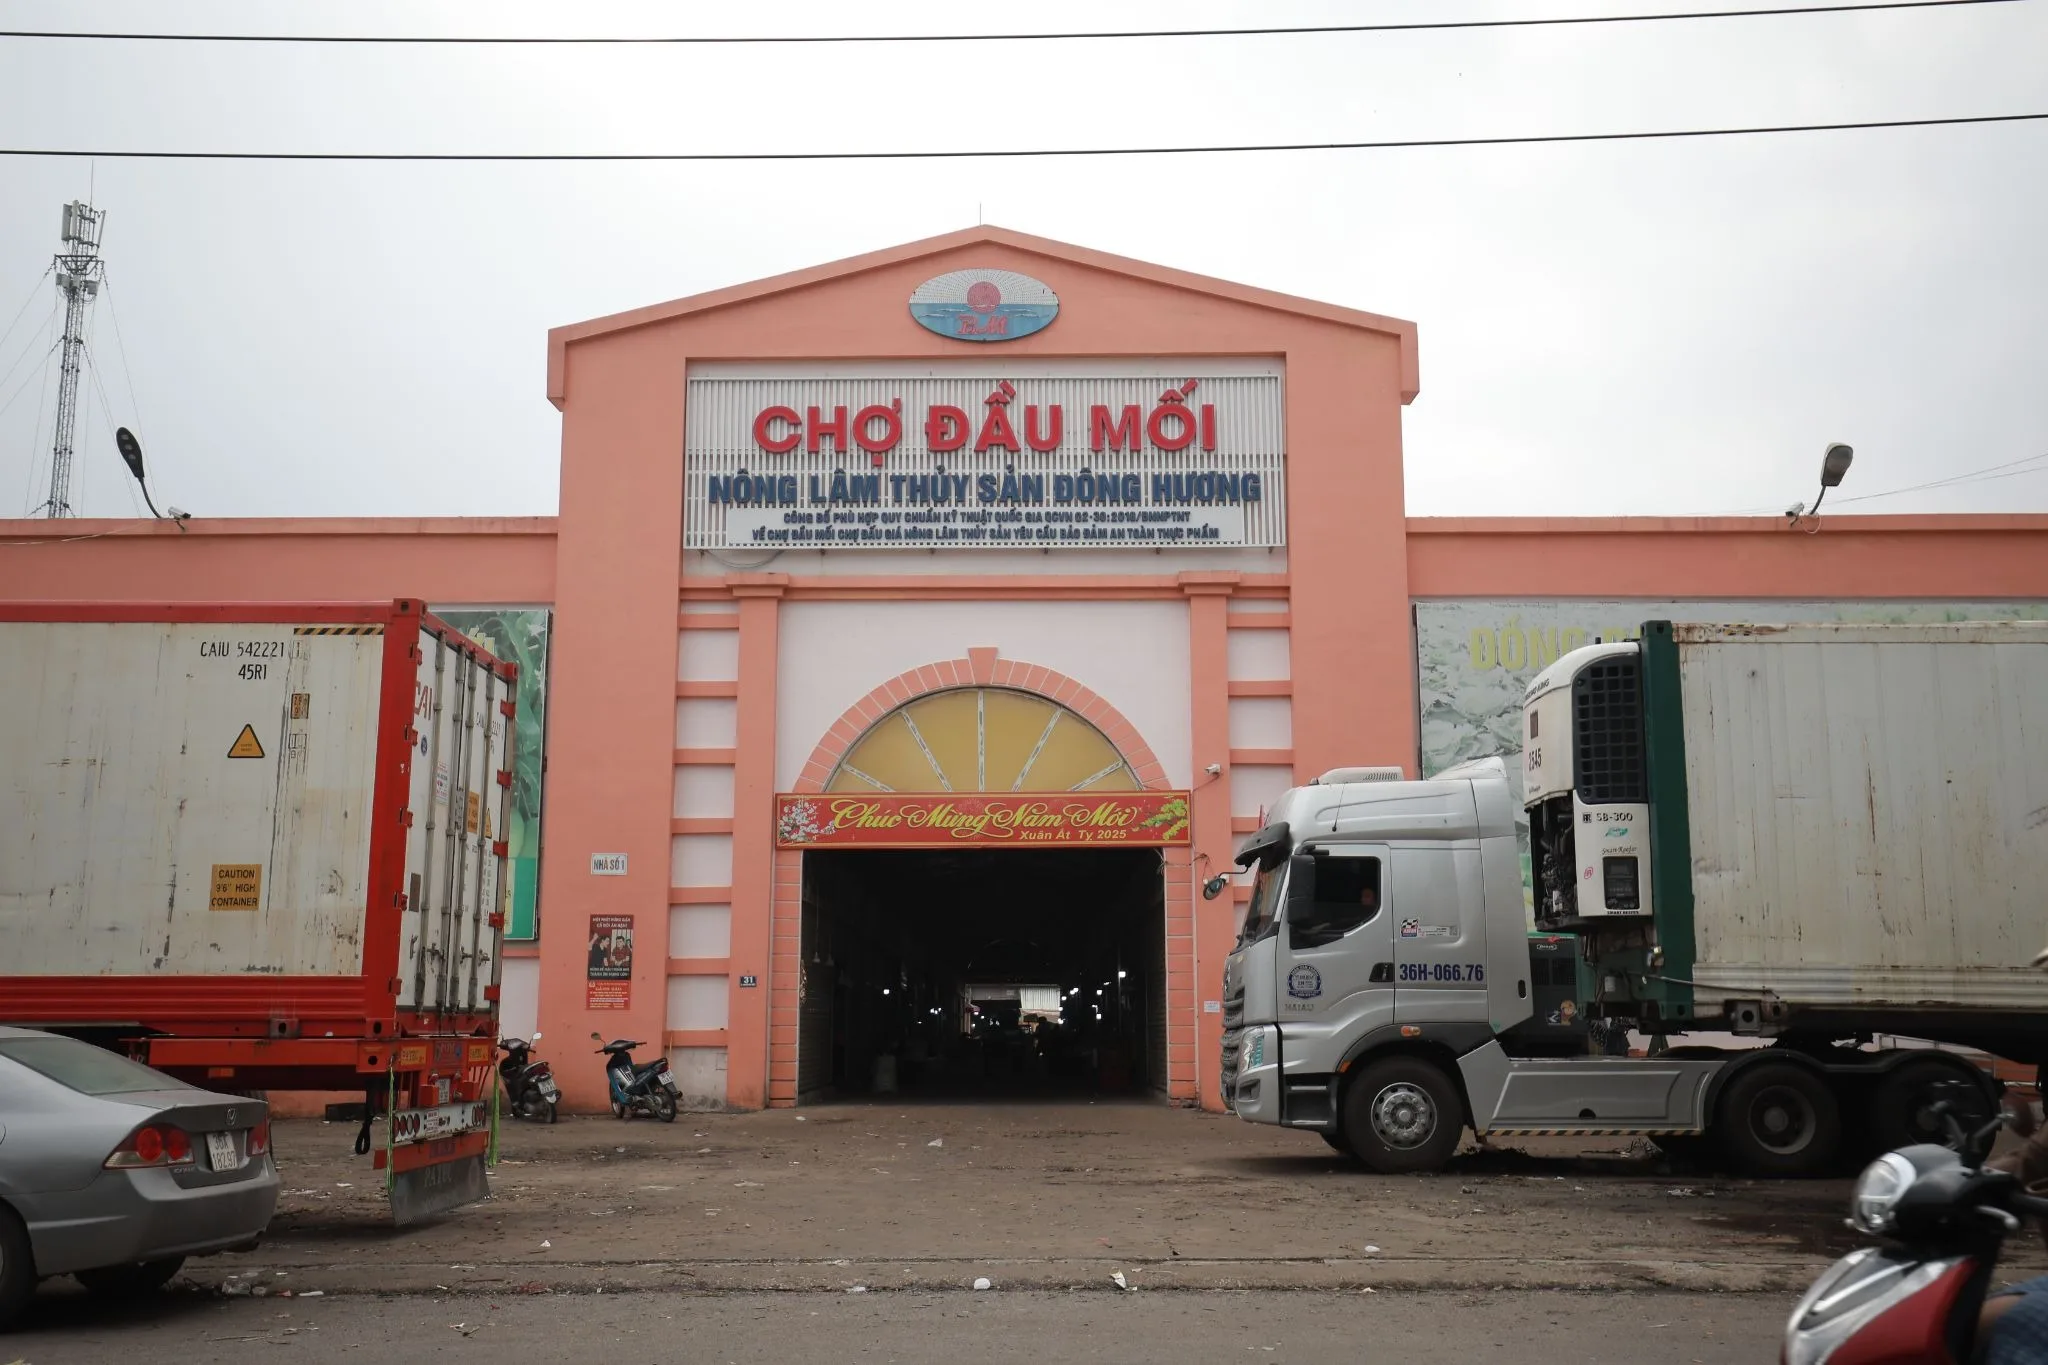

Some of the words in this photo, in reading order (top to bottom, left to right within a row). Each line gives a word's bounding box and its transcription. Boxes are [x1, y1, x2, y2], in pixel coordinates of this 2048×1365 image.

[753, 397, 901, 467] CHỢ
[925, 380, 1063, 453] ĐẦU
[1091, 378, 1216, 453] MỐI
[708, 468, 798, 504] NÔNG
[810, 468, 880, 504] LÂM
[889, 464, 970, 504] THỦY
[977, 463, 1044, 504] SẢN
[1053, 466, 1141, 504] ĐÔNG
[1152, 470, 1262, 504] HƯƠNG
[784, 510, 813, 524] CÔNG
[816, 508, 831, 524] BỐ
[833, 510, 855, 524] PHÙ
[858, 511, 879, 526] HỢP
[881, 512, 902, 524] QUY
[904, 507, 941, 523] CHUẨN
[943, 509, 957, 523] KỸ
[960, 509, 993, 525] THUẬT
[994, 506, 1023, 524] QUỐC
[1024, 511, 1043, 523] GIA
[1044, 510, 1073, 523] QCVN
[767, 528, 789, 542] CHỢ
[815, 525, 835, 540] MỐI
[838, 528, 860, 542] CHỢ
[884, 525, 903, 540] GIÁ
[904, 526, 933, 540] NÔNG
[935, 525, 959, 540] LÂM
[960, 524, 988, 540] THỦY
[989, 524, 1012, 540] SẢN
[1013, 525, 1034, 540] YÊU
[1060, 524, 1081, 540] BẢO
[1082, 523, 1108, 539] ĐẢM
[1109, 528, 1126, 539] AN
[1127, 525, 1155, 539] TOÀN
[1157, 527, 1184, 541] THỰC
[1186, 522, 1219, 539] PHẨM
[200, 641, 230, 658] CAIU
[237, 641, 285, 658] 542221
[238, 664, 267, 681] 45R1
[1528, 747, 1542, 772] 2545
[831, 799, 902, 829] Chúc
[900, 801, 1008, 838] Mừng
[986, 801, 1064, 828] Năm
[1063, 800, 1137, 828] Mới
[1597, 812, 1633, 822] SB-300
[1097, 829, 1127, 840] 2025
[218, 869, 255, 879] CAUTION
[235, 883, 256, 893] HIGH
[211, 897, 258, 907] CONTAINER
[743, 976, 754, 984] 31
[1400, 963, 1484, 981] 36H-066.76
